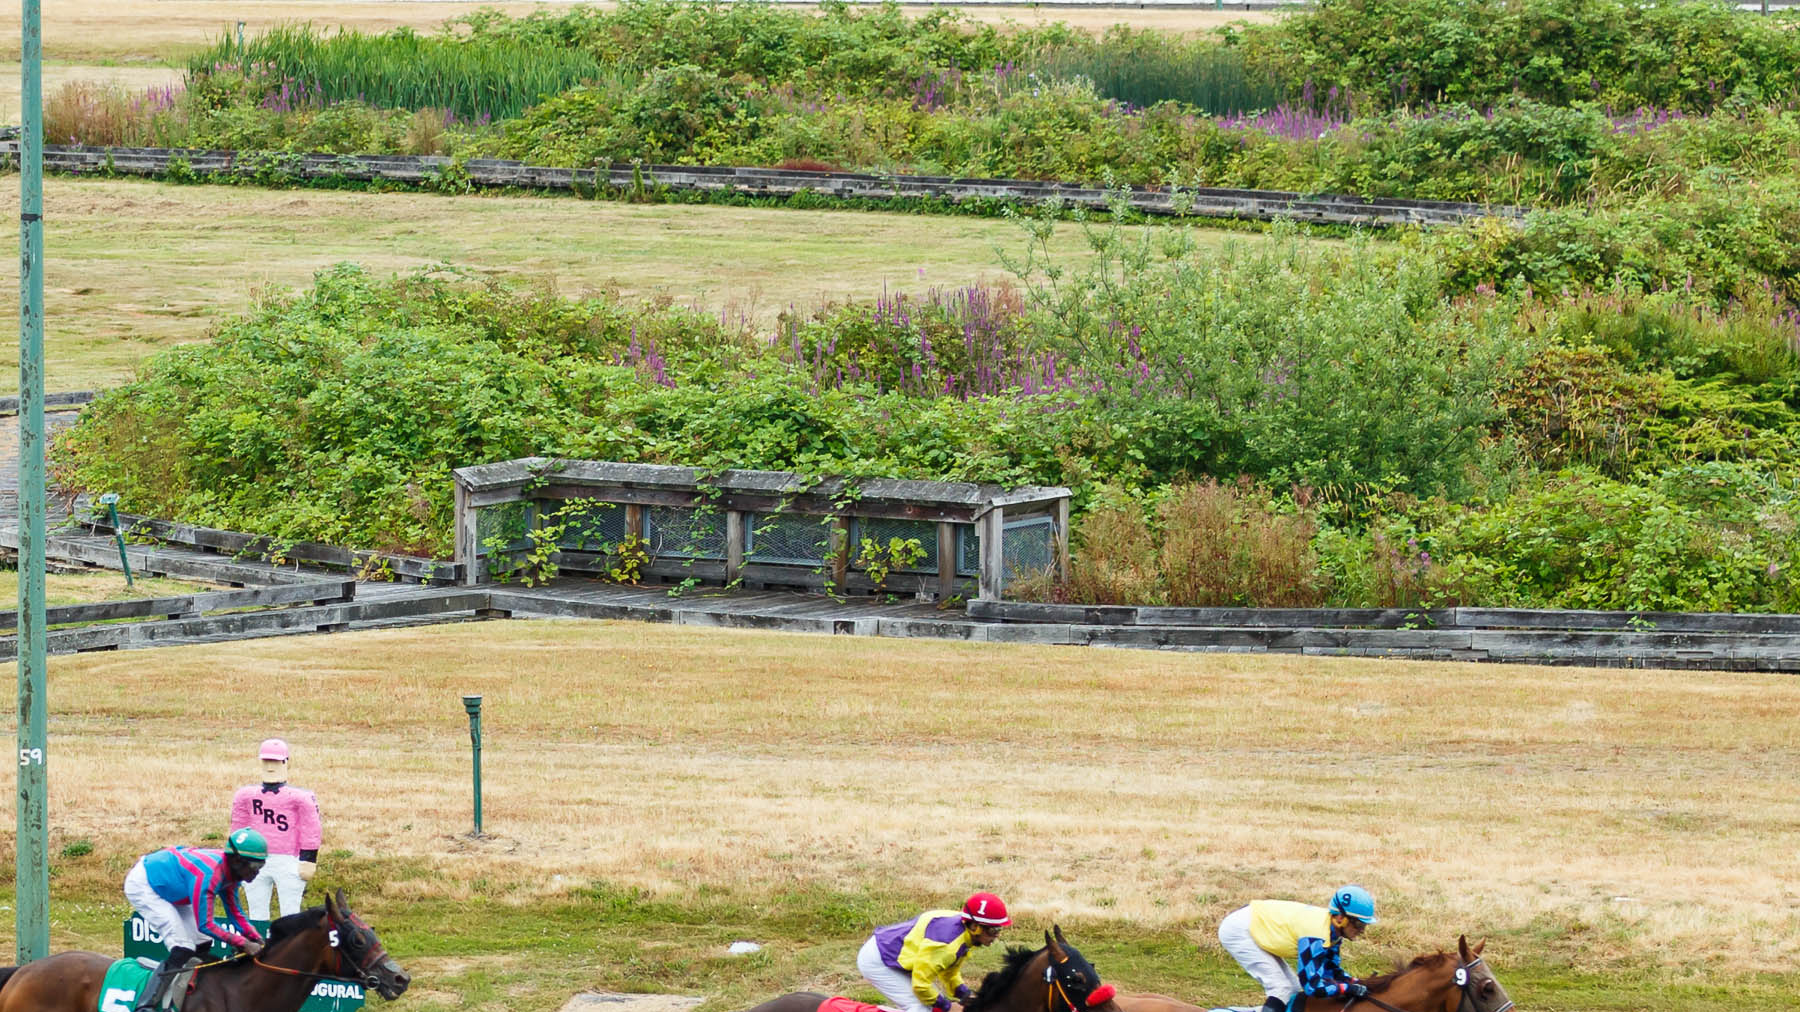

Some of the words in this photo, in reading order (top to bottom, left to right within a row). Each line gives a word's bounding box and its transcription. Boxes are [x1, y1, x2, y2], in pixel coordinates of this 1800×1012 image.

[20, 748, 42, 765] 59
[252, 799, 289, 832] RRS
[977, 900, 987, 915] 1
[1342, 893, 1351, 907] 9
[329, 930, 340, 948] 5
[1455, 967, 1467, 985] 9
